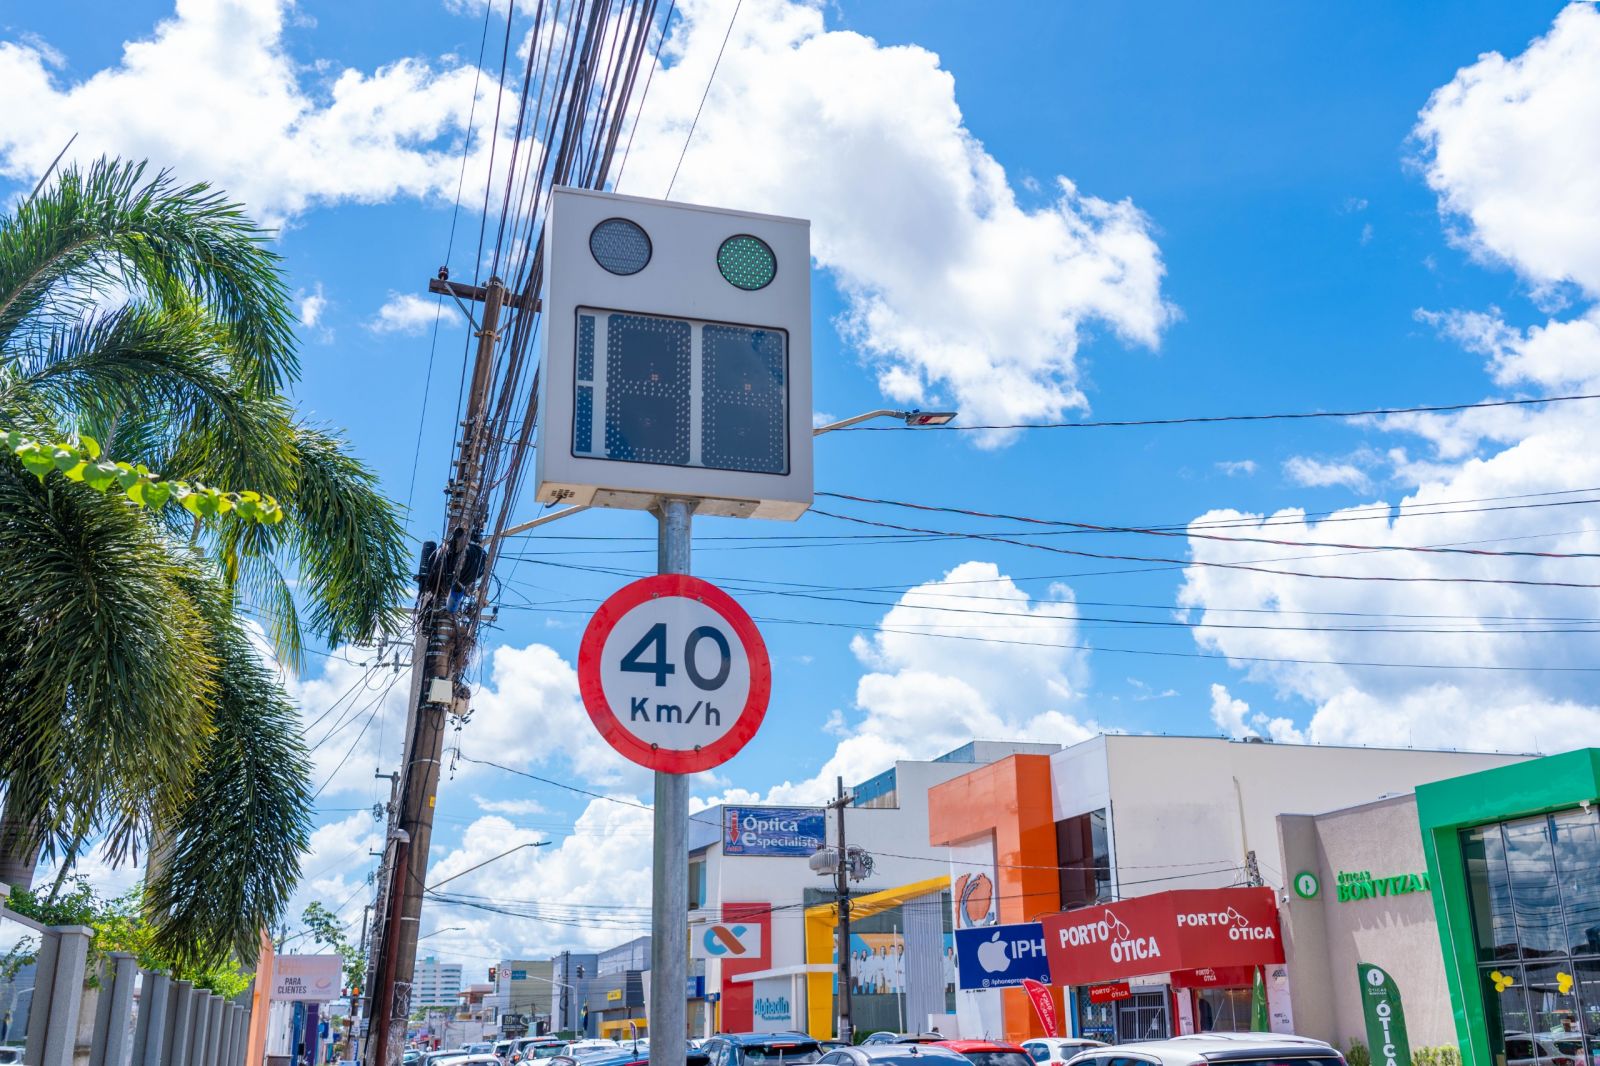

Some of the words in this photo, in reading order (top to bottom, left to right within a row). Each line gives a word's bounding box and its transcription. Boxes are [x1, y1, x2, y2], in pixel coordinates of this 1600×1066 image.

[620, 622, 732, 691] 40
[630, 697, 721, 726] Km/h
[742, 814, 799, 834] Óptica
[741, 832, 818, 849] especialista
[1337, 870, 1371, 884] ÓTICAS
[1176, 912, 1229, 927] PORTO
[1059, 920, 1109, 949] PORTO
[1228, 924, 1275, 941] ÓTICA
[1011, 938, 1047, 959] IPH
[1110, 936, 1161, 963] ÓTICA
[277, 985, 307, 994] CLIENTES
[284, 977, 301, 986] PARA
[1091, 987, 1110, 996] PORTO
[754, 996, 790, 1019] Alphaclin
